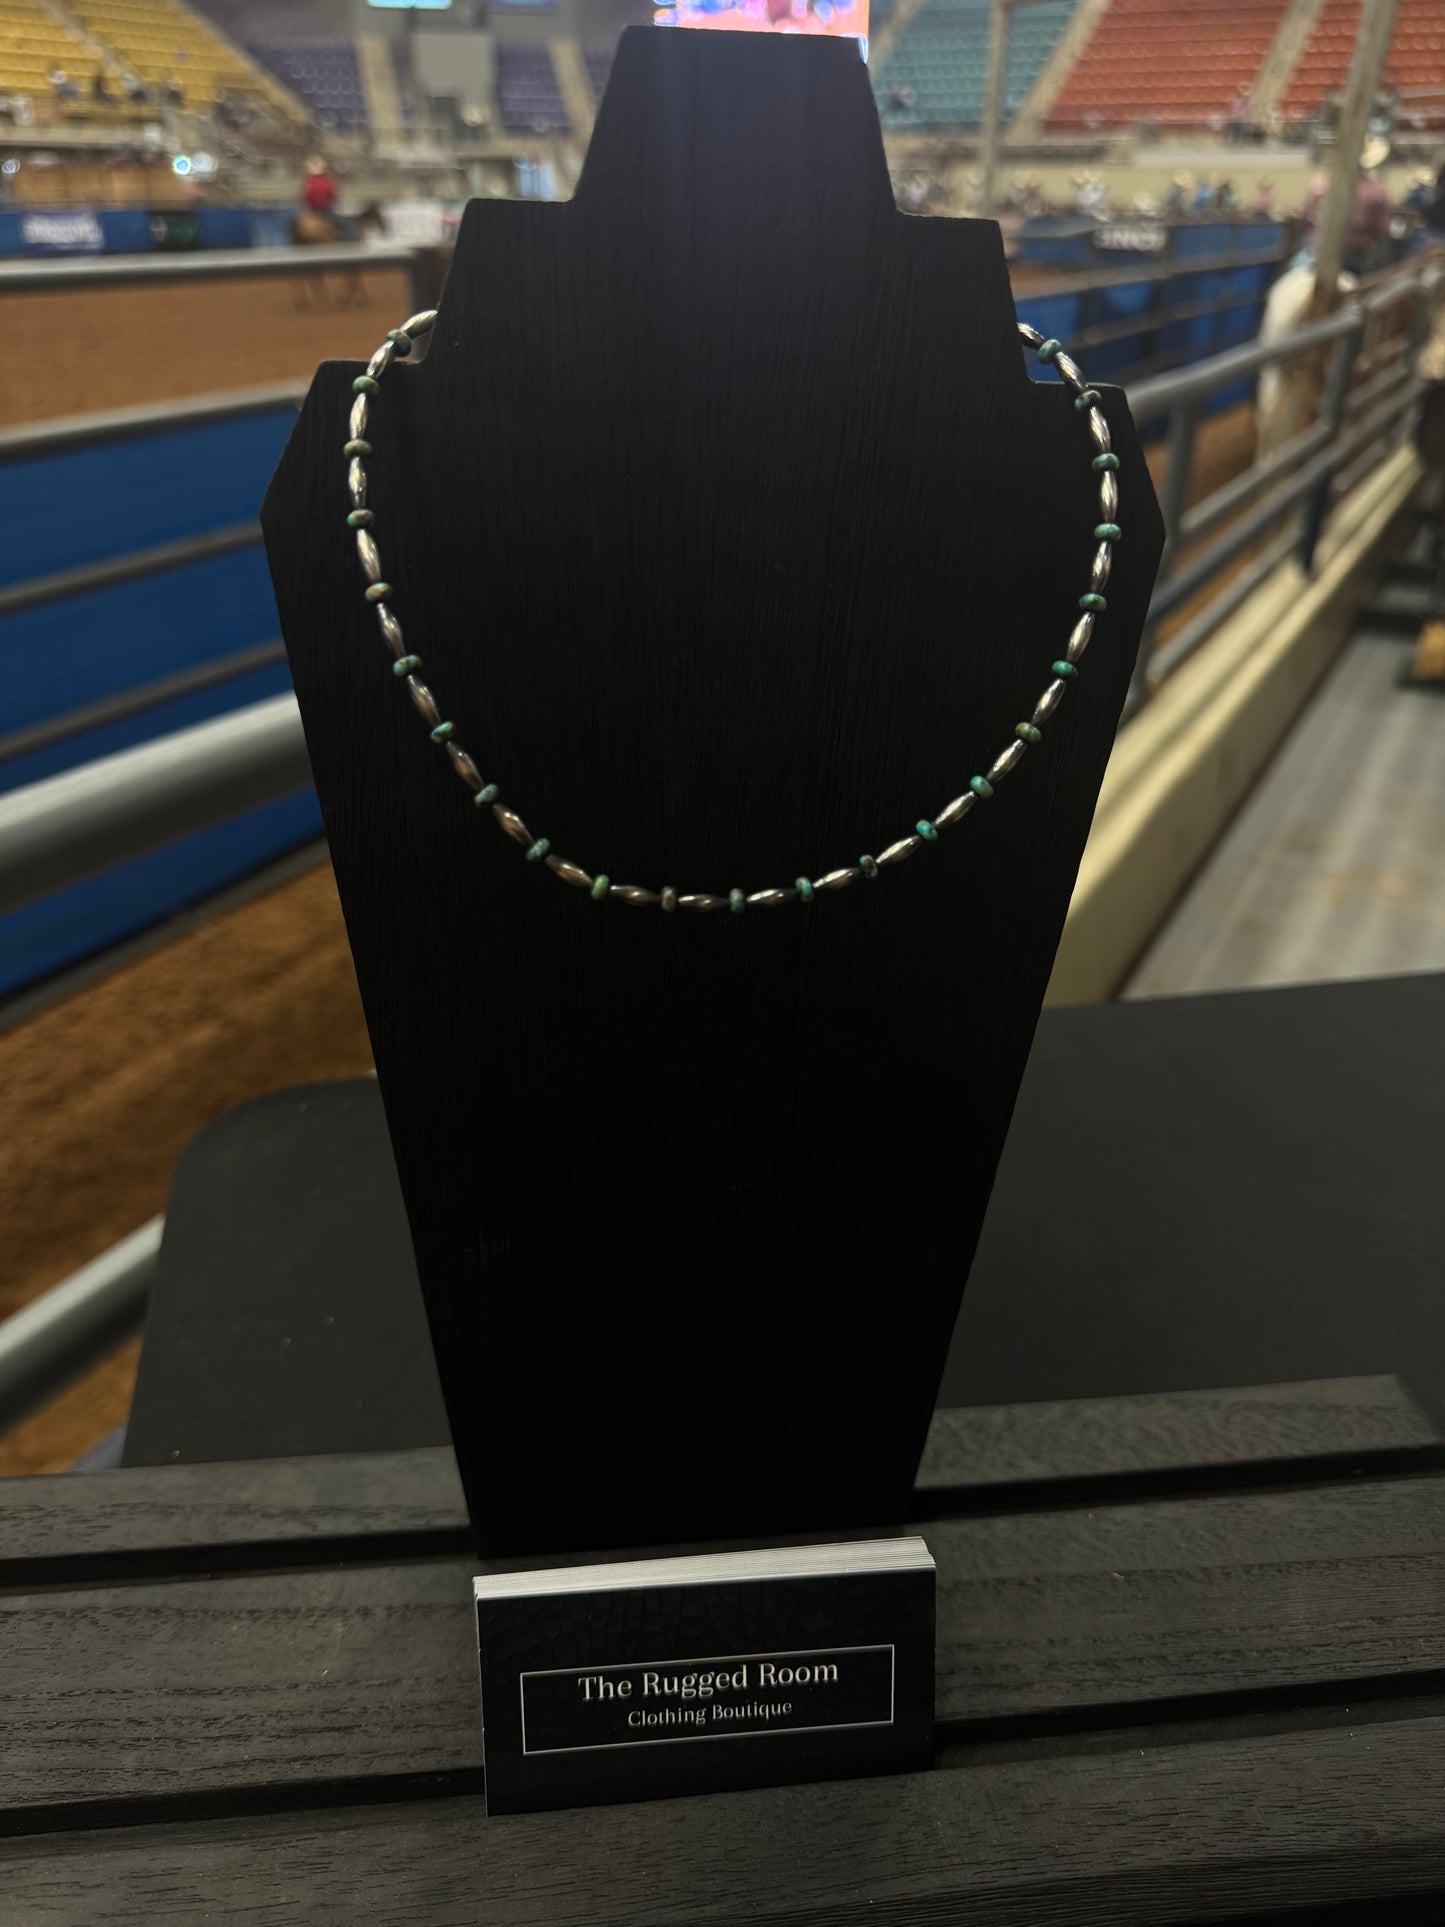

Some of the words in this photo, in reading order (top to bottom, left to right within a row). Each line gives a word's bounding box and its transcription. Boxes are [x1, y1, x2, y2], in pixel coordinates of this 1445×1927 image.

[577, 1676, 632, 1700] The
[642, 1664, 748, 1698] Rugged
[759, 1662, 839, 1686] Room
[627, 1705, 706, 1726] Clothing
[712, 1701, 793, 1720] Boutique
